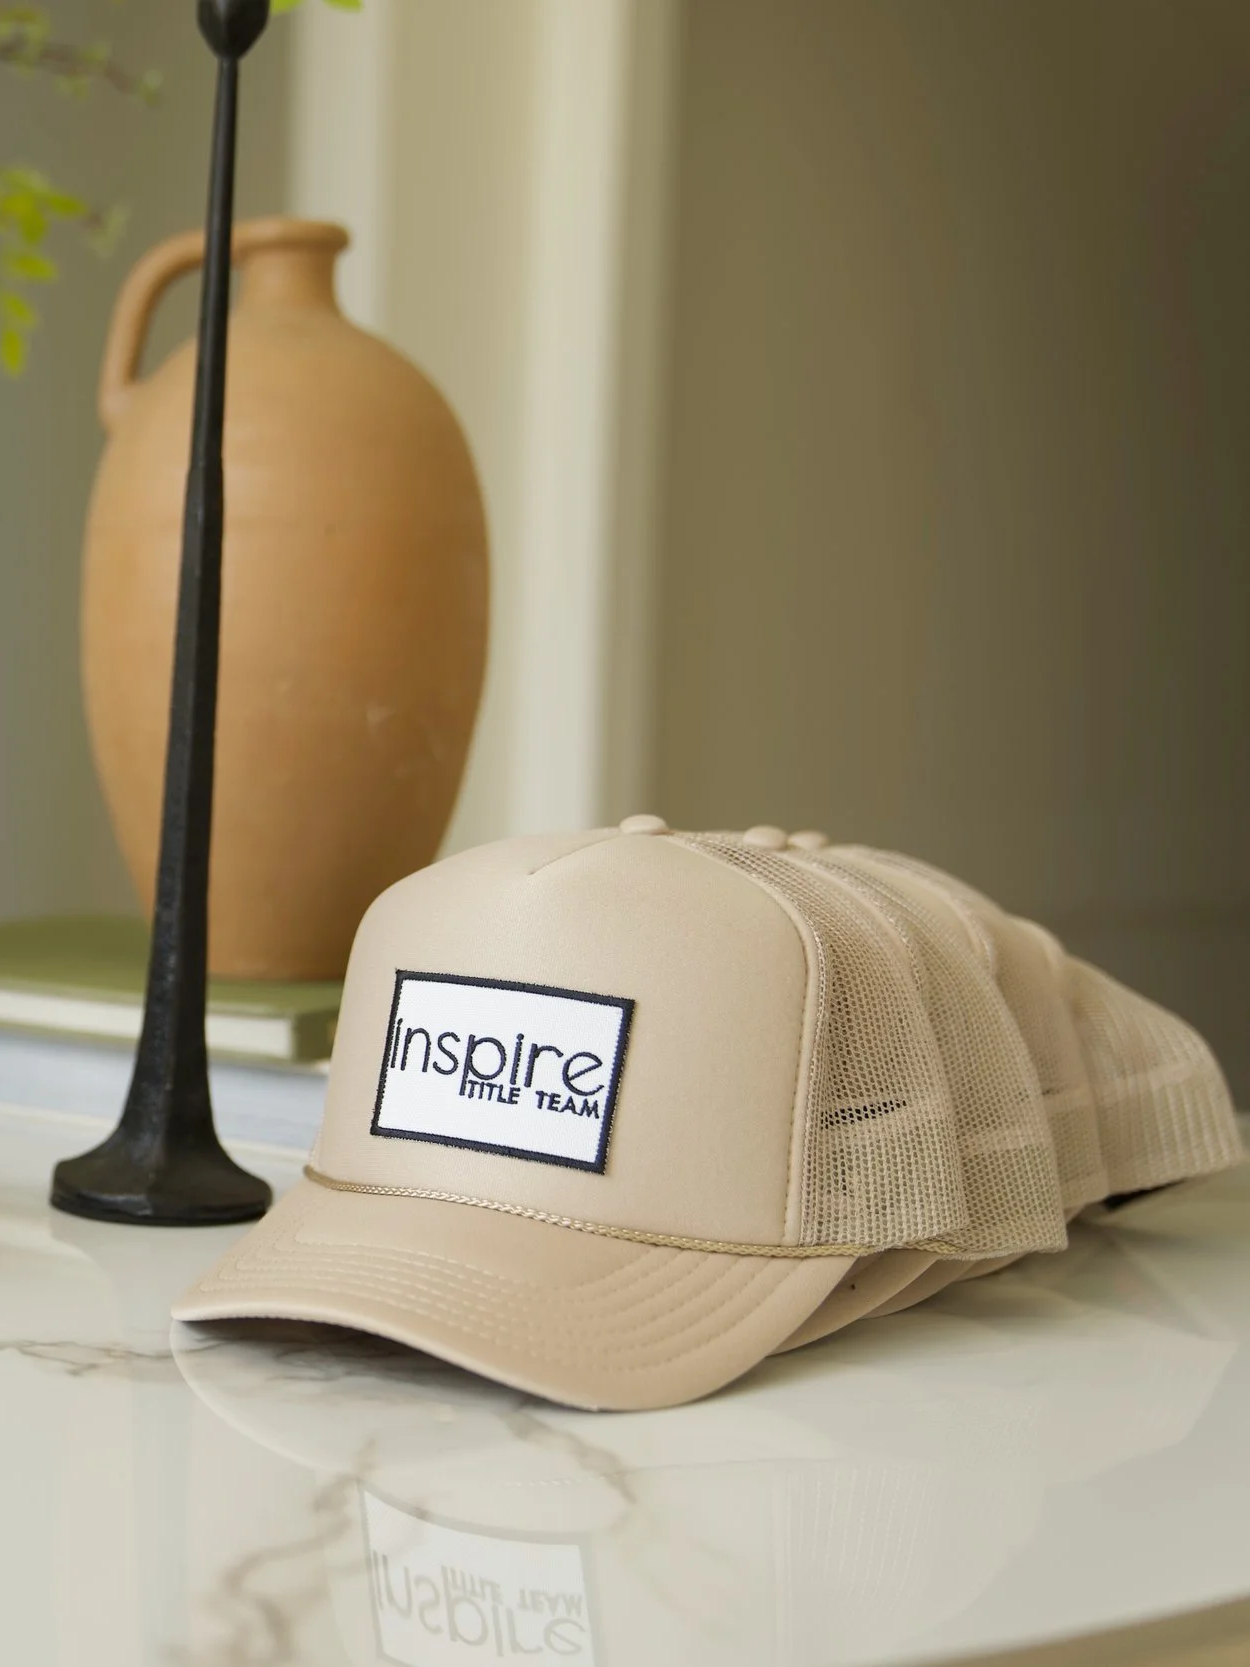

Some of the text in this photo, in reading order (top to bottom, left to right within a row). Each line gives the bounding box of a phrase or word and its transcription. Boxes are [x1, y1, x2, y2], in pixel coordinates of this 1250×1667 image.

[391, 1018, 605, 1097] inspire
[467, 1080, 600, 1119] TITLE TEAM
